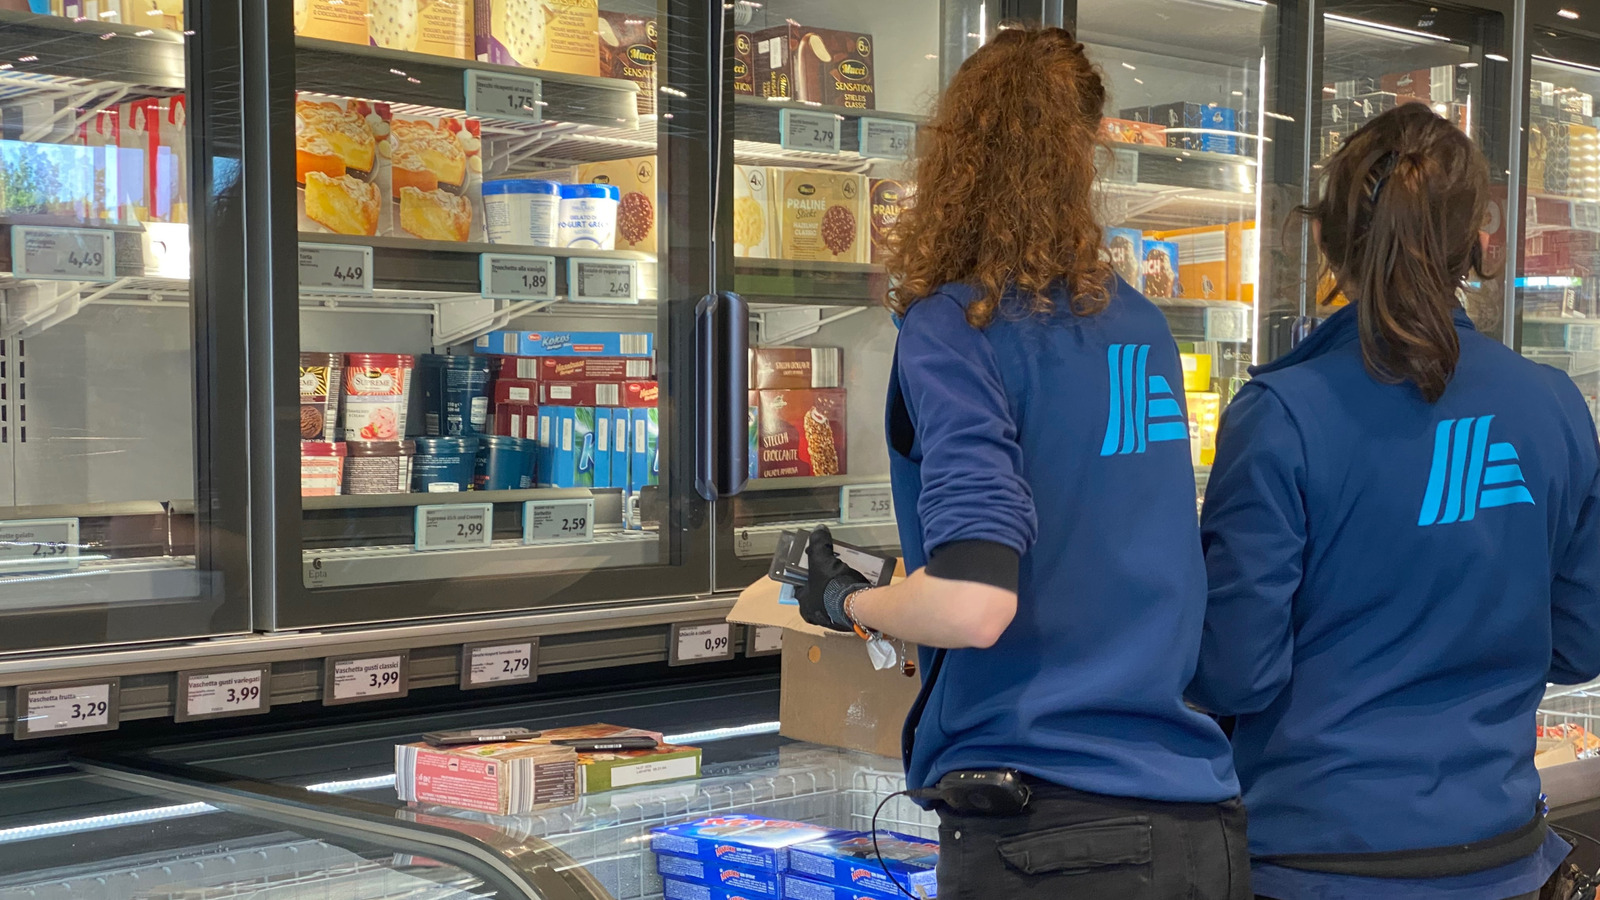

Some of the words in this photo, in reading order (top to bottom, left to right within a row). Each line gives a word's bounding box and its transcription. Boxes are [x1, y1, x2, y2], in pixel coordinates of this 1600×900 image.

[842, 62, 866, 75] Mucci
[835, 82, 873, 93] SENSATION
[508, 94, 533, 109] 1,75
[845, 101, 866, 109] CLASSIC
[814, 129, 833, 142] 2,79
[787, 197, 826, 211] PRALINÉ
[68, 251, 102, 268] 4,49
[333, 266, 363, 281] 4,49
[522, 274, 546, 289] 1,89
[610, 282, 629, 294] 2,49
[763, 432, 789, 448] STECCHI
[763, 449, 798, 462] CROCCANTE
[871, 500, 890, 512] 2,55
[457, 523, 483, 538] 2,99
[562, 517, 586, 532] 2,59
[308, 570, 327, 579] Epta
[705, 637, 727, 651] 0,99
[335, 666, 363, 674] Vaschetta
[364, 663, 378, 672] gusti
[379, 661, 398, 670] classici
[502, 657, 529, 674] 2,79
[188, 680, 217, 688] Vaschetta
[219, 678, 233, 687] gusti
[234, 676, 260, 684] variegati
[369, 671, 398, 688] 3,99
[29, 695, 57, 703] Vaschetta
[227, 686, 259, 704] 3,99
[71, 701, 107, 720] 3,29
